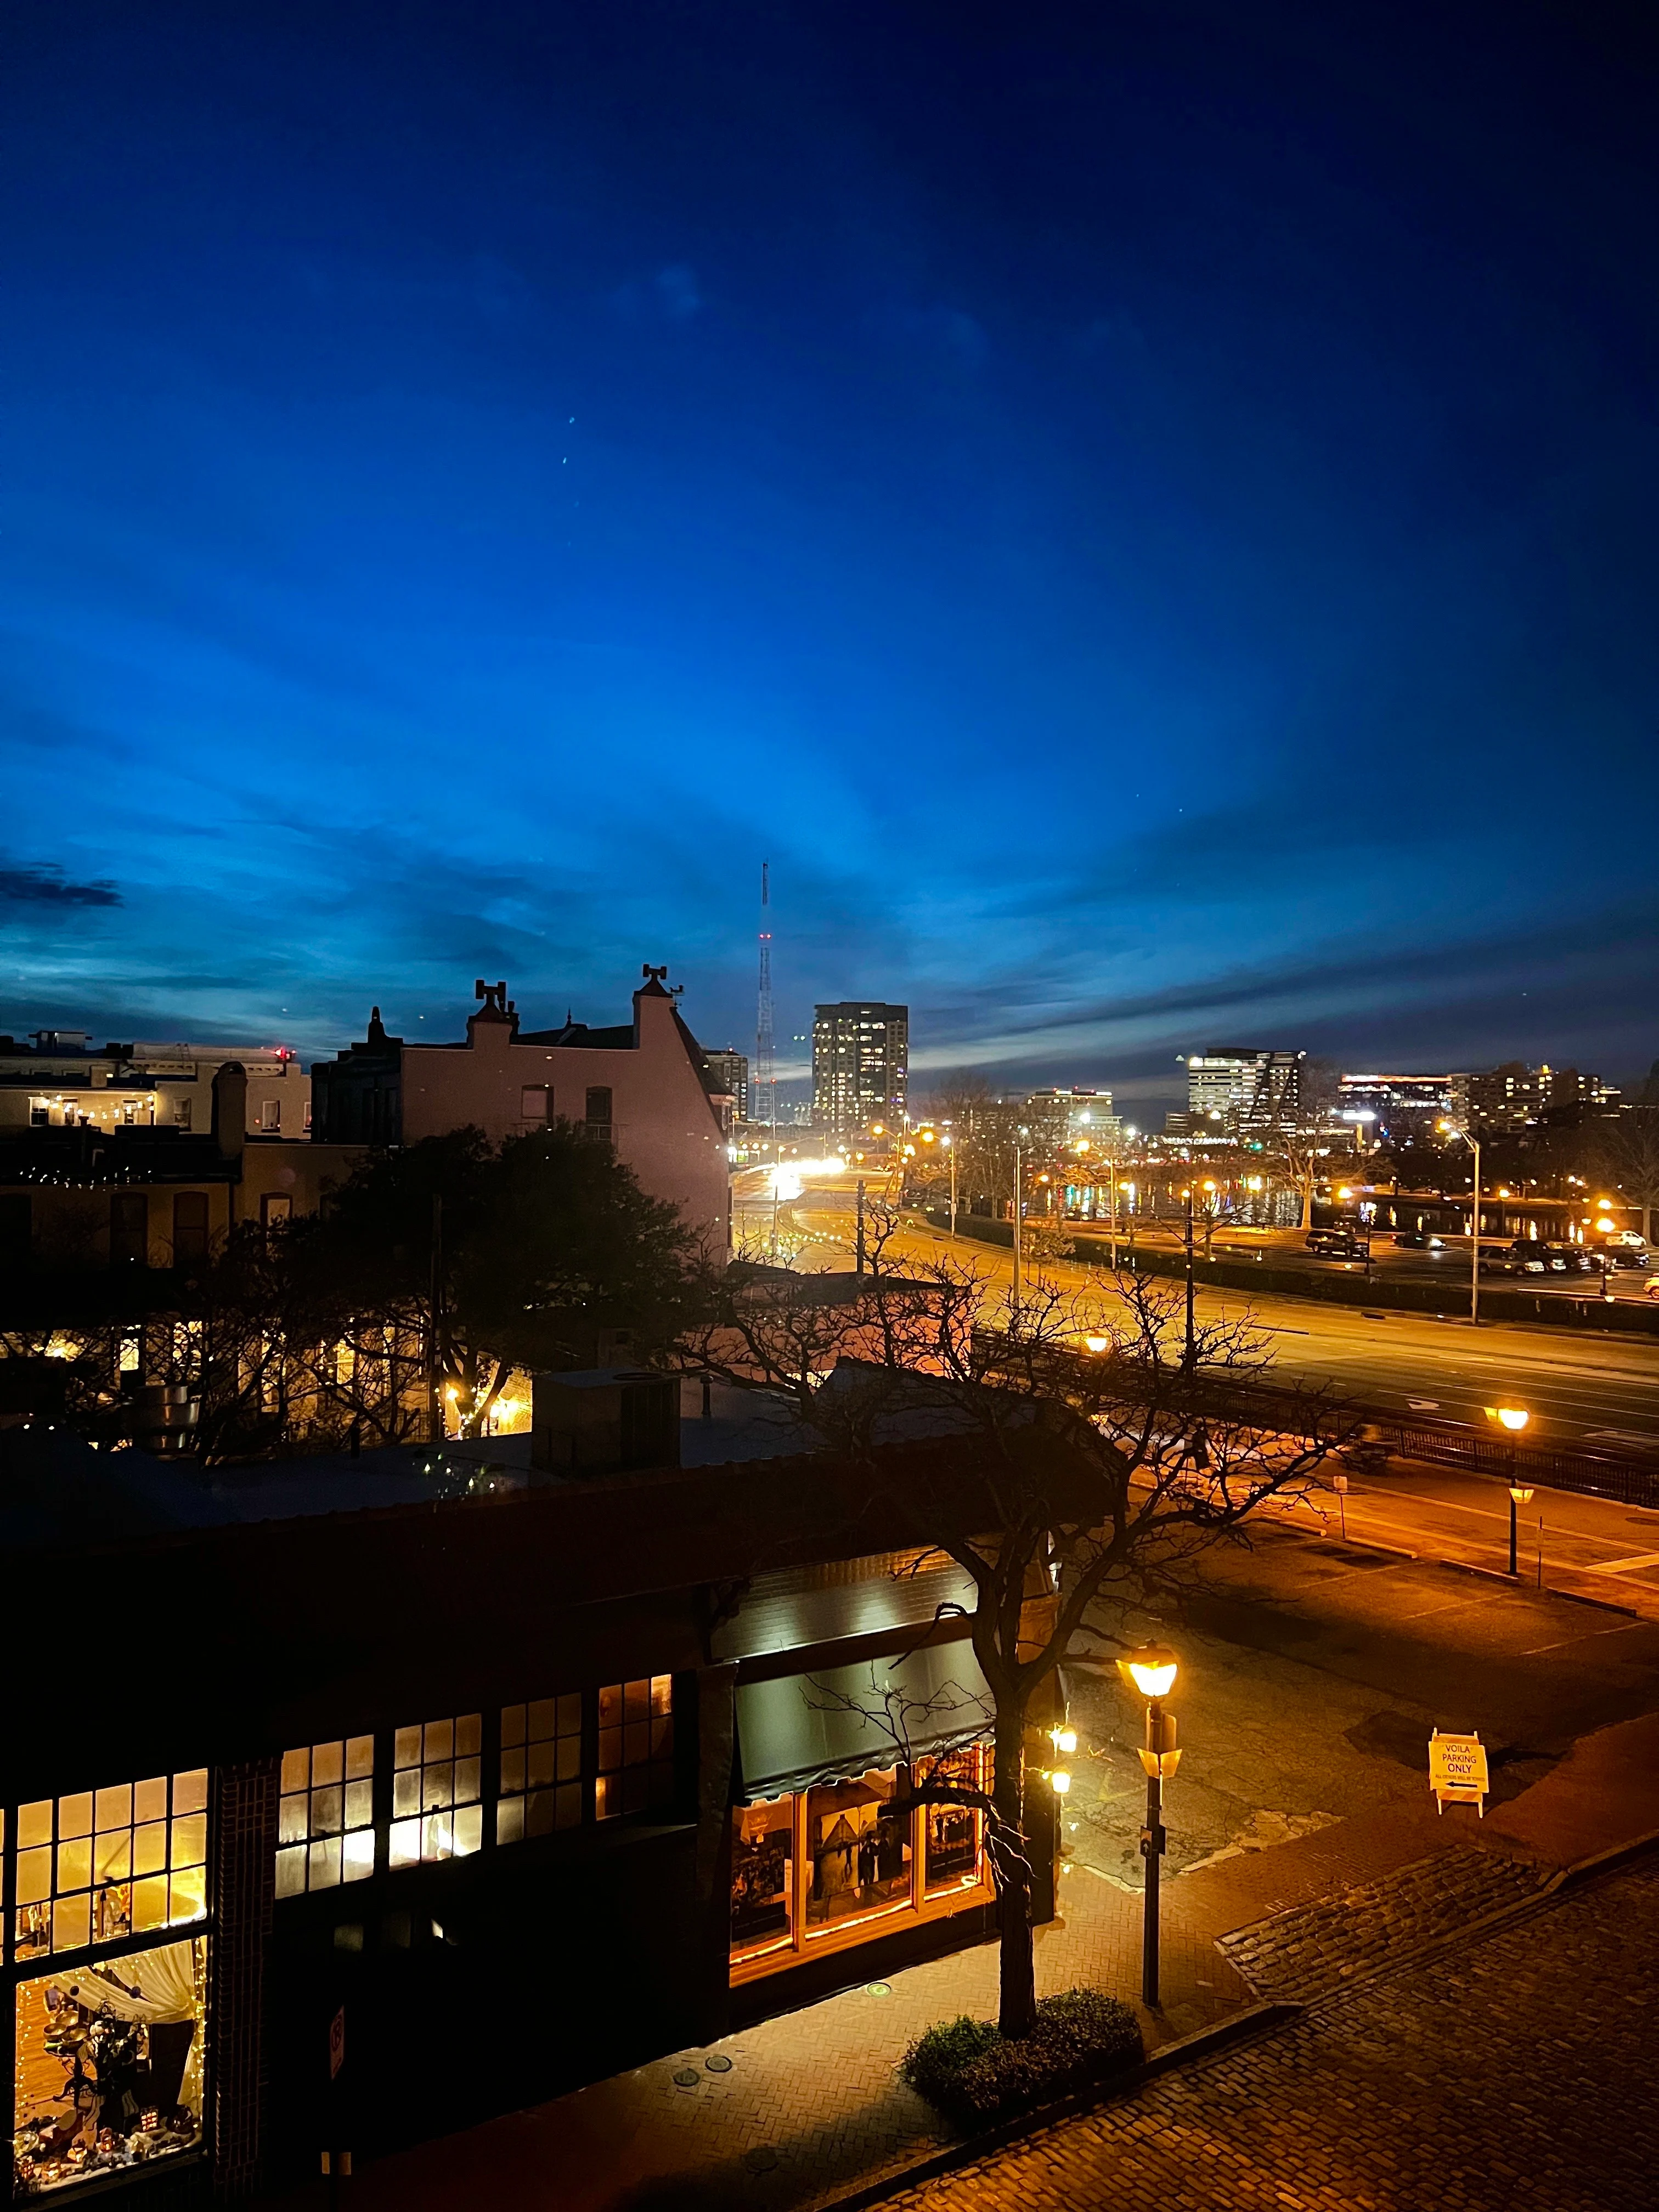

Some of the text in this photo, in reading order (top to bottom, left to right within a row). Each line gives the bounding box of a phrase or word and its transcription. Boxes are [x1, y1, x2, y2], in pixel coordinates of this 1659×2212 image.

[1445, 1745, 1470, 1753] VOILA
[1442, 1753, 1476, 1763] PARKING
[1448, 1763, 1472, 1773] ONLY
